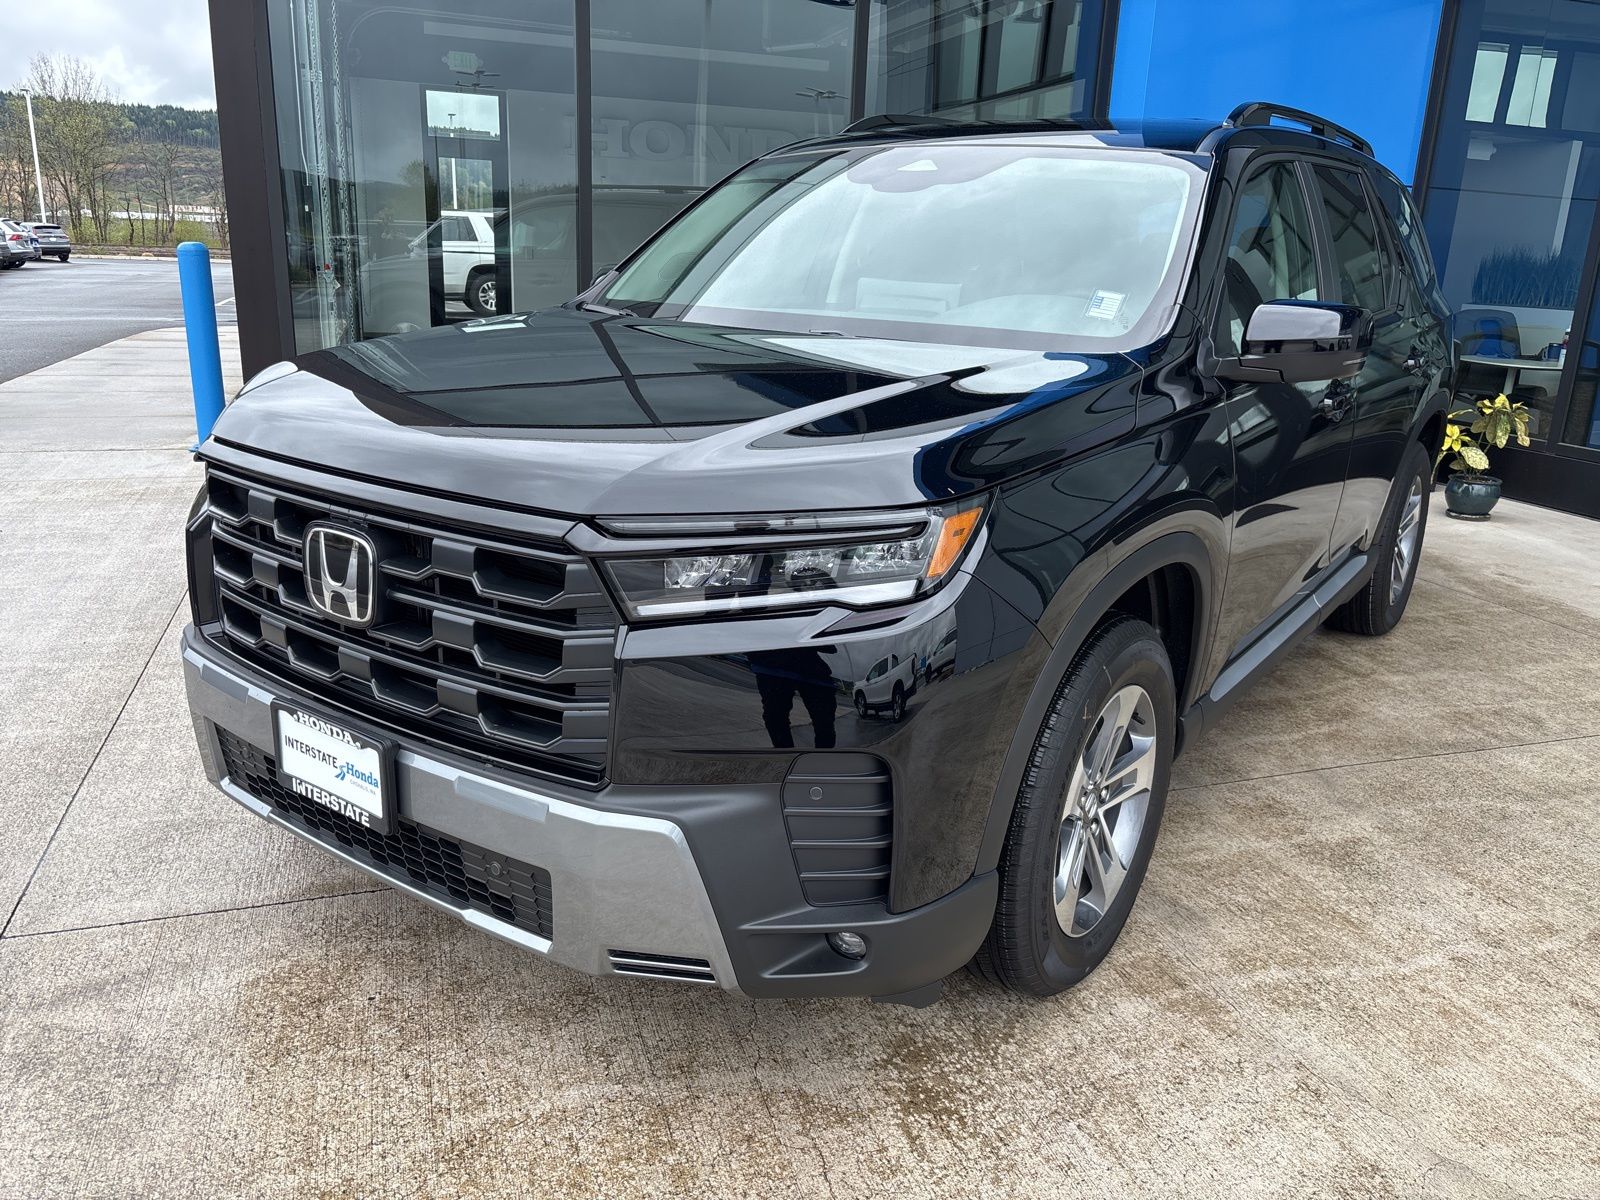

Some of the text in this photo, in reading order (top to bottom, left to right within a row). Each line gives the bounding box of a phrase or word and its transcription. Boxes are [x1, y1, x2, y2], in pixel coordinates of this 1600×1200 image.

[296, 711, 356, 747] HONDA
[284, 735, 339, 769] INTERSTATE
[345, 761, 379, 789] Honda
[291, 777, 371, 828] INTERSTATE
